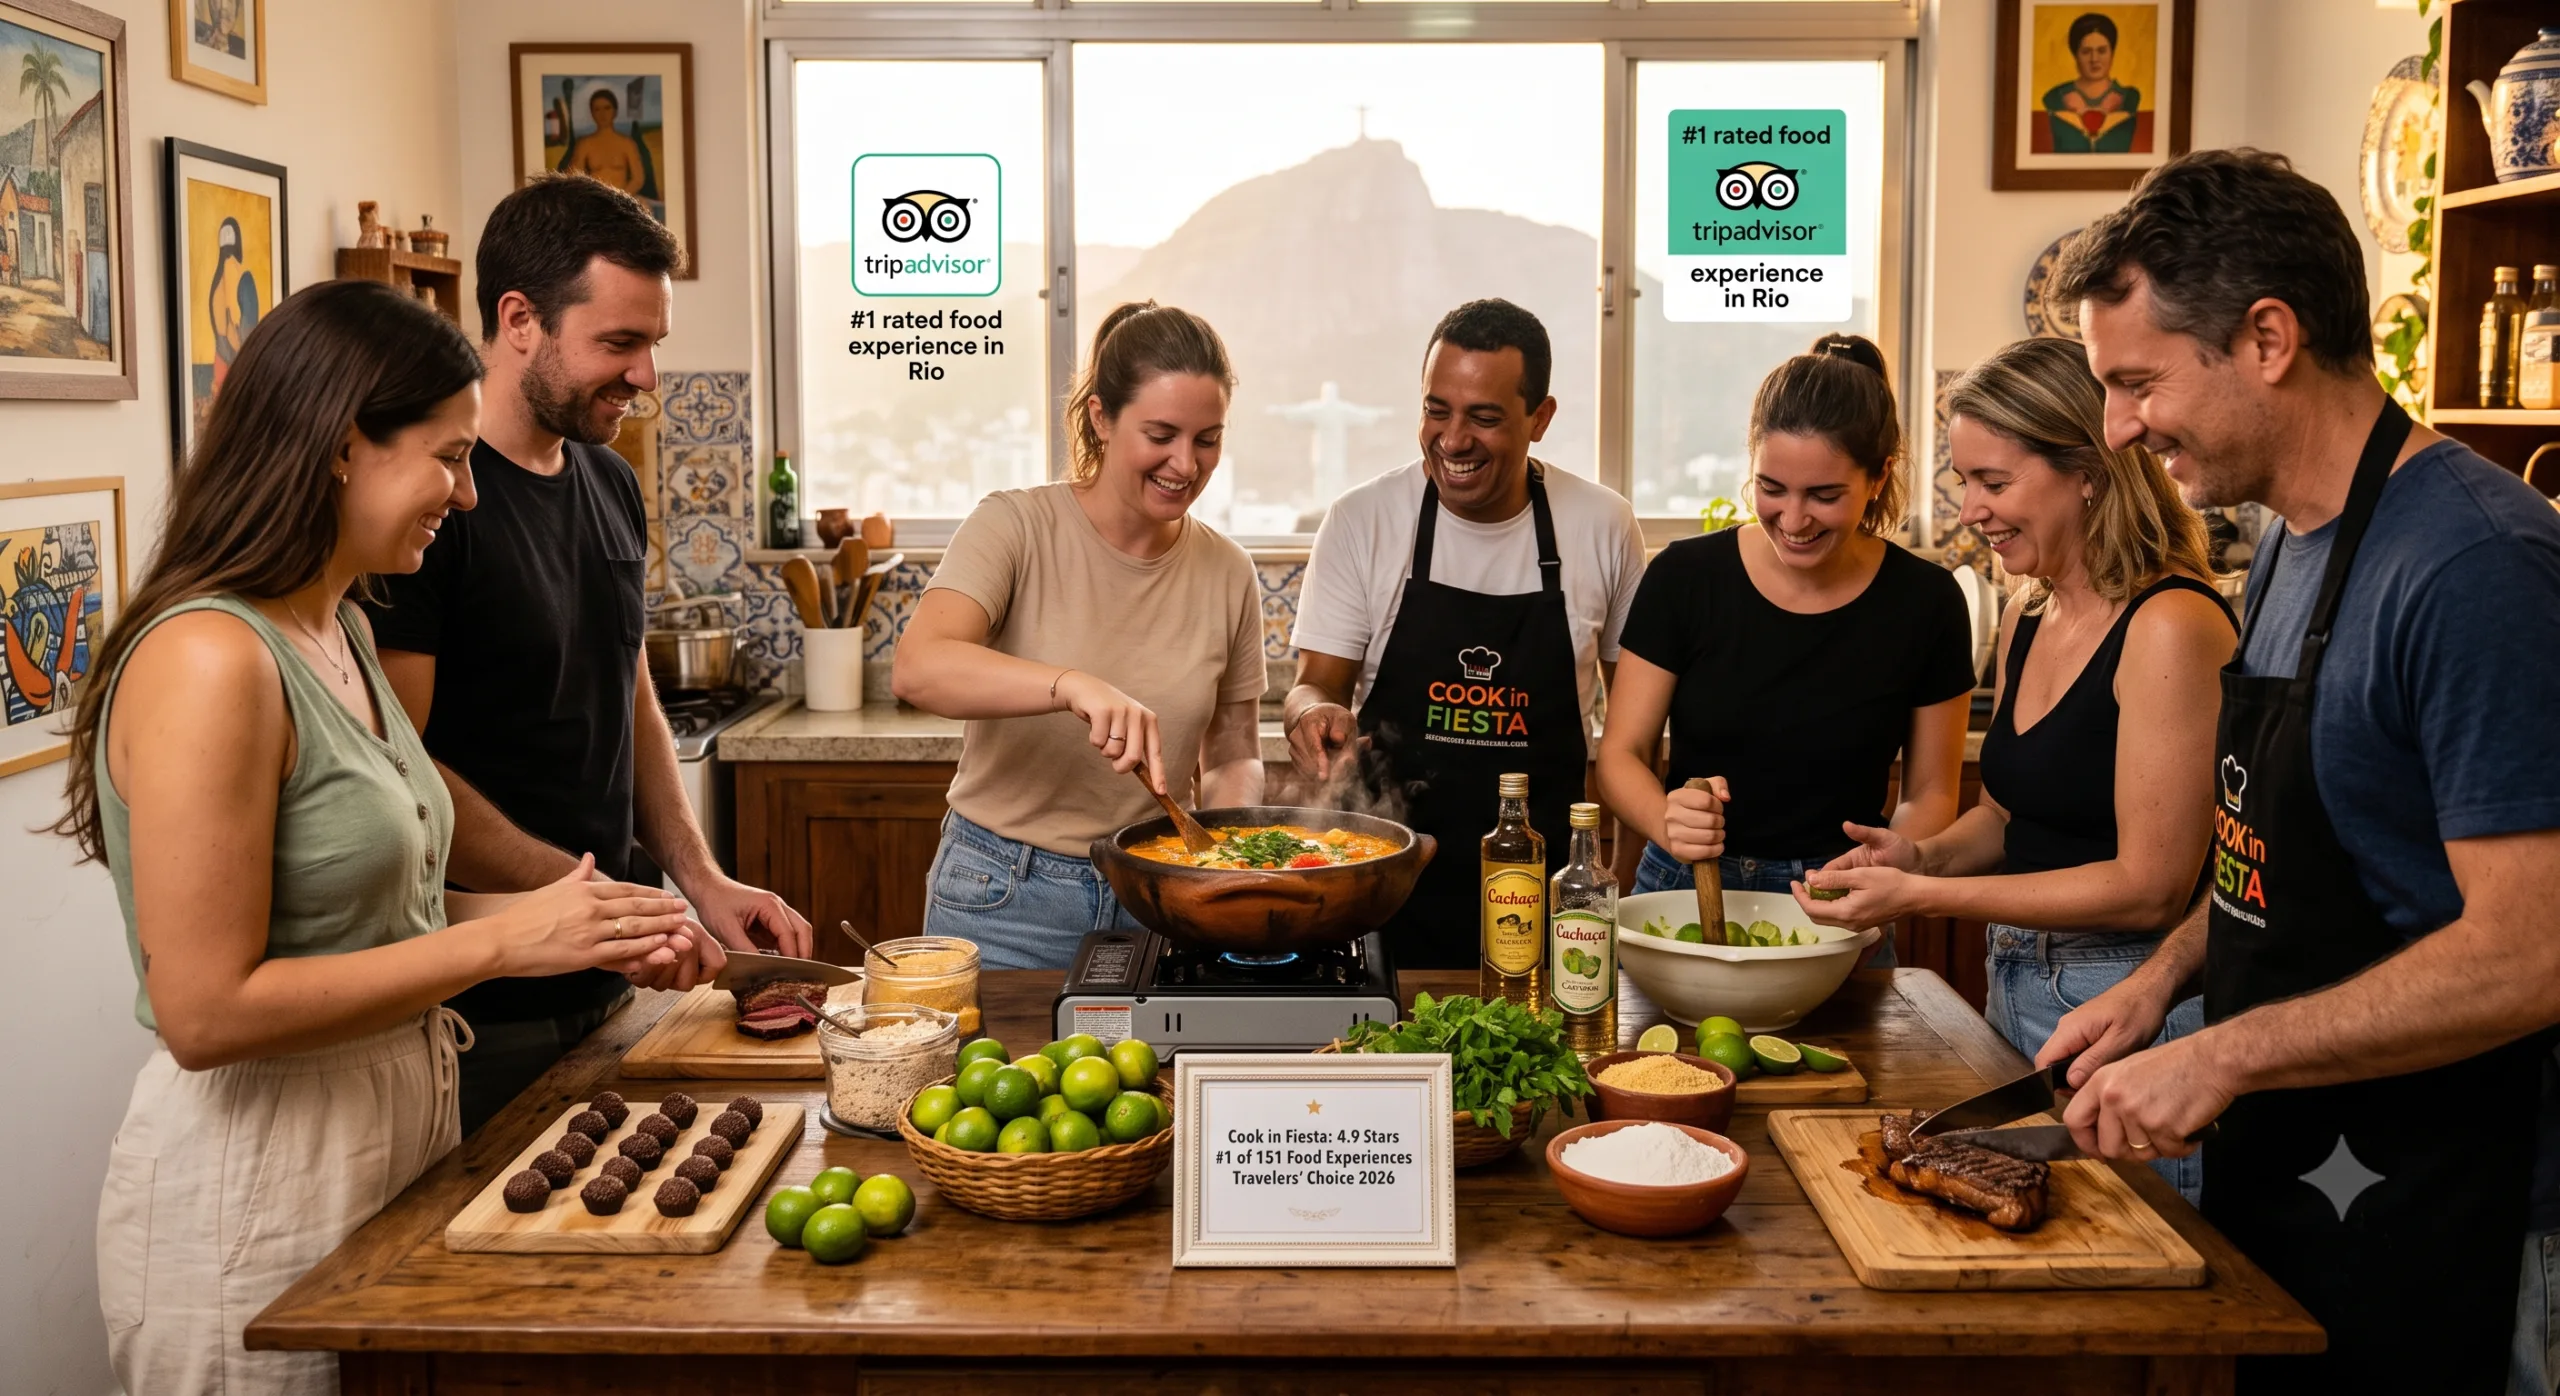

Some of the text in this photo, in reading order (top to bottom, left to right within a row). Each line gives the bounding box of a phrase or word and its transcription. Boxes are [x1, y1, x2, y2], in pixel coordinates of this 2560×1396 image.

[1428, 681, 1529, 707] COOK in
[1426, 704, 1529, 735] FIESTA
[2248, 828, 2266, 863] in
[1488, 888, 1540, 908] Cachaça
[1556, 923, 1607, 945] Cachaça
[1228, 1129, 1400, 1144] Cook in Fiesta: 4.9 Stars
[1216, 1149, 1413, 1168] #1 of 151 Food Experiences
[1307, 1170, 1355, 1185] Choice
[1358, 1170, 1395, 1185] 2026
